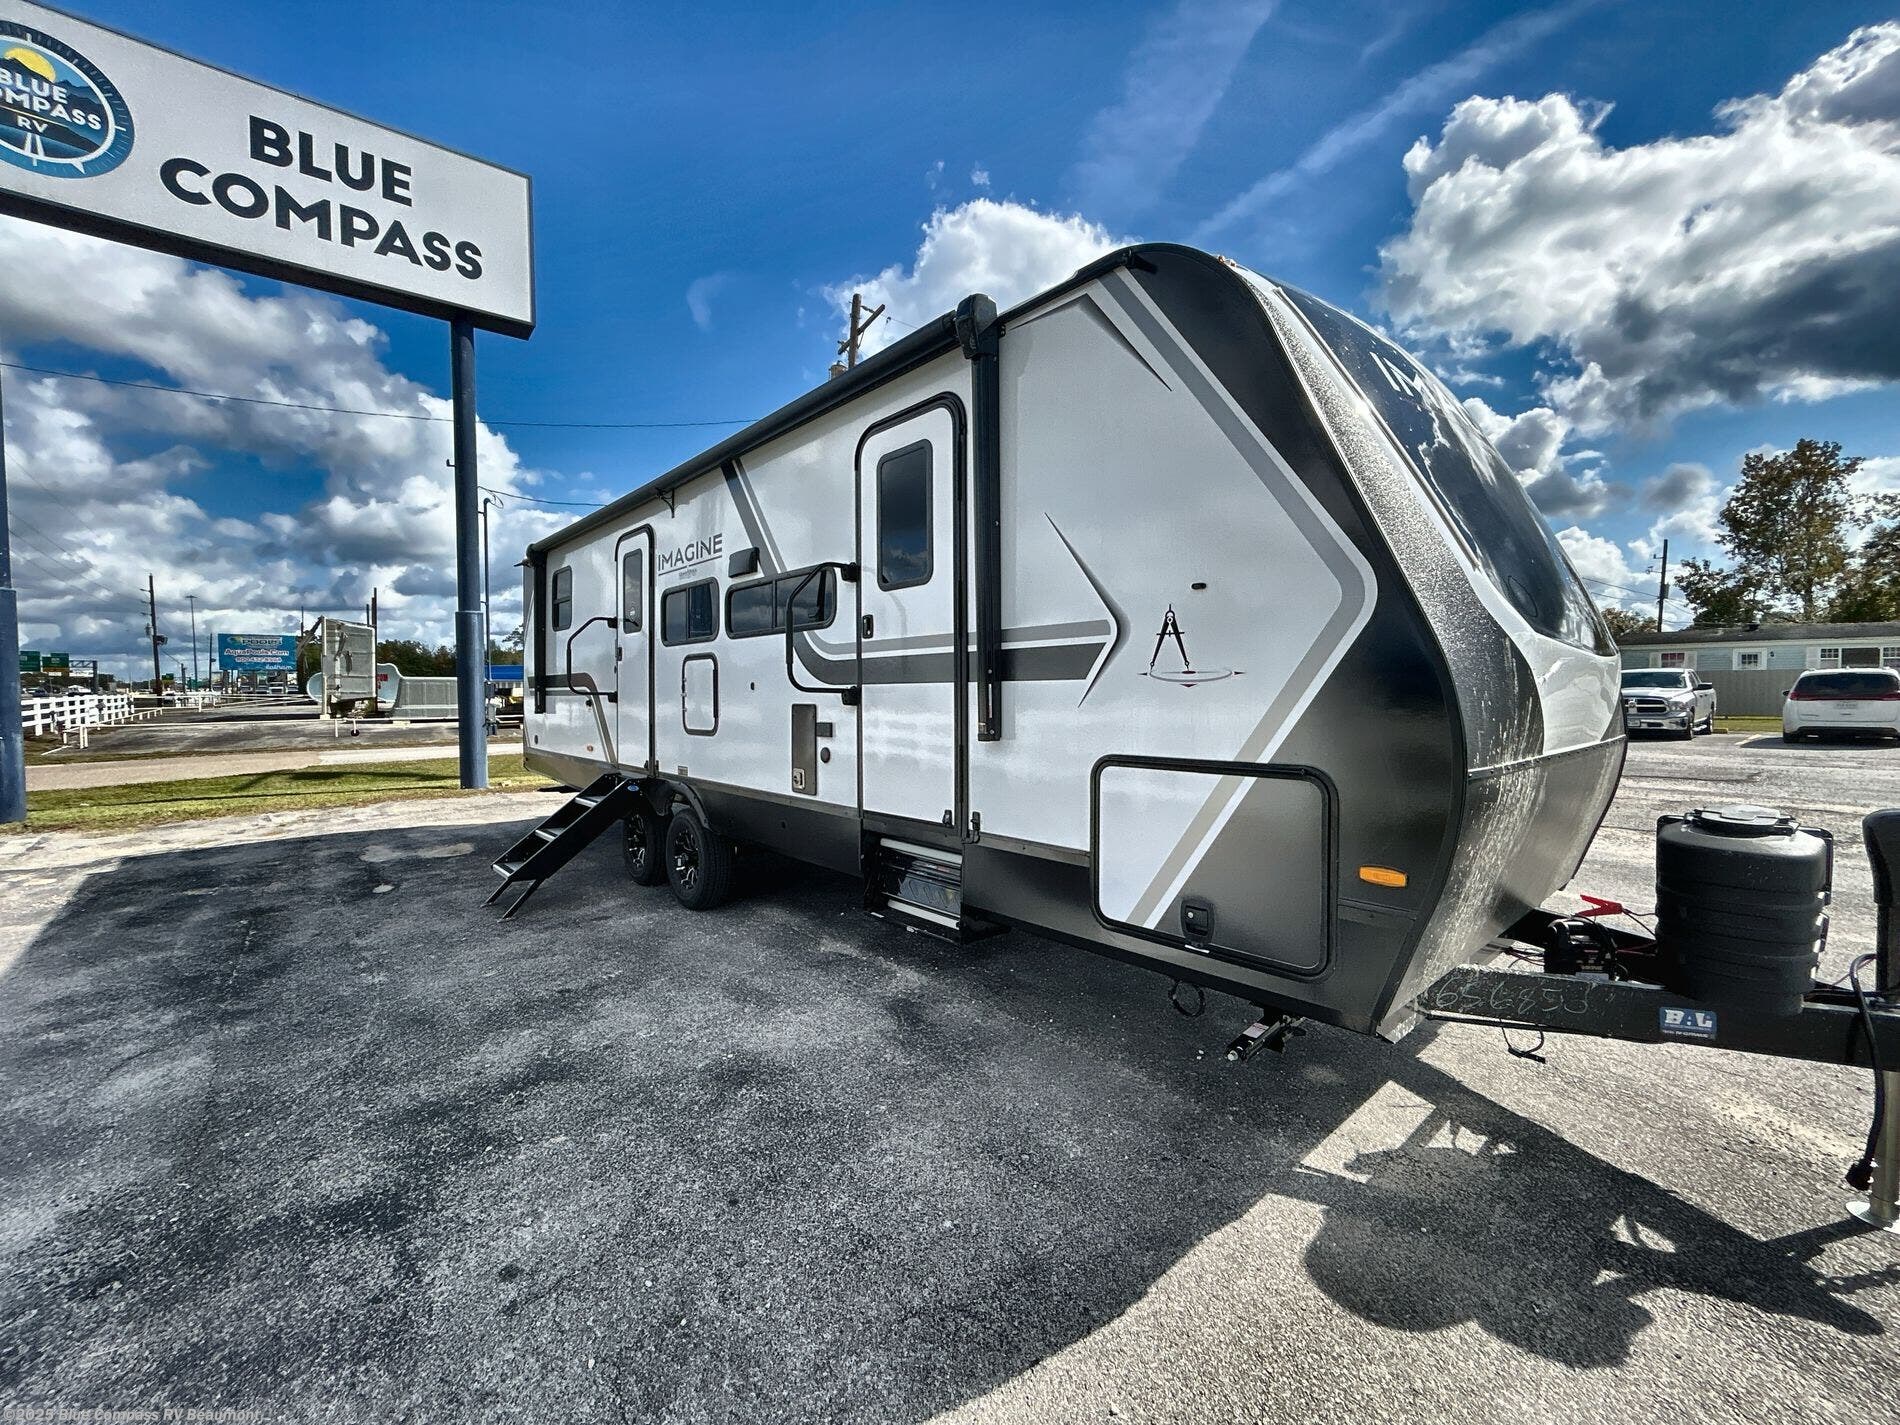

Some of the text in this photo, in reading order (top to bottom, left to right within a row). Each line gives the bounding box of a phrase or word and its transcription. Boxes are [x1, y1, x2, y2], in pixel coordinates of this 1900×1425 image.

[0, 67, 68, 104] BLUE
[17, 115, 48, 133] RV
[249, 114, 412, 207] BLUE
[159, 157, 483, 280] COMPASS
[658, 532, 723, 572] IMAGINE
